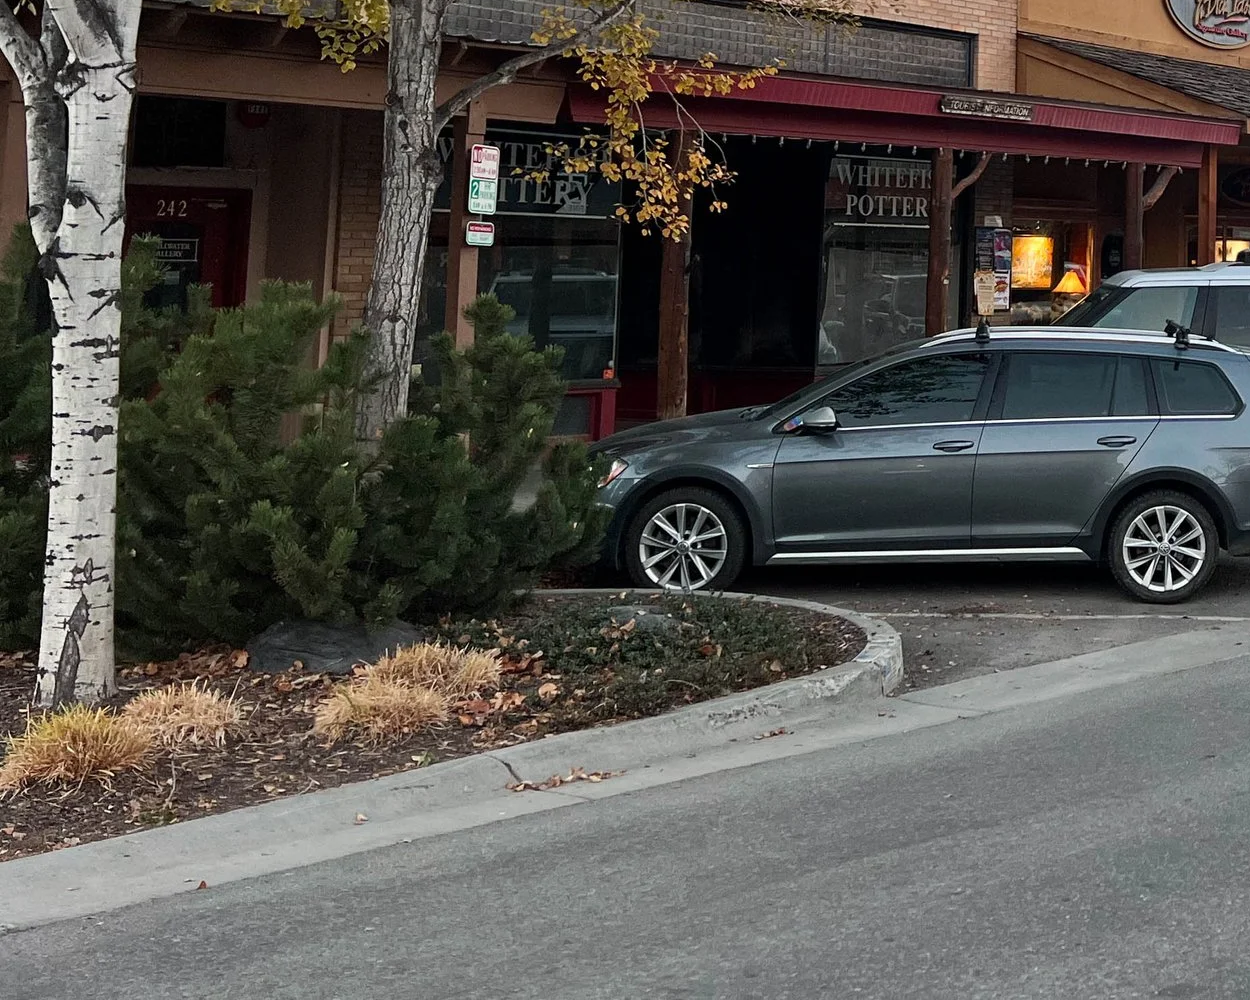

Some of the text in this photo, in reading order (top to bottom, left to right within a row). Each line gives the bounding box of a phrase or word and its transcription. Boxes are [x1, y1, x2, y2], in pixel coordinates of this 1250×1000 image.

[472, 182, 479, 198] 2
[157, 200, 188, 217] 242
[845, 194, 929, 218] POTTER
[155, 250, 183, 258] ALLERY
